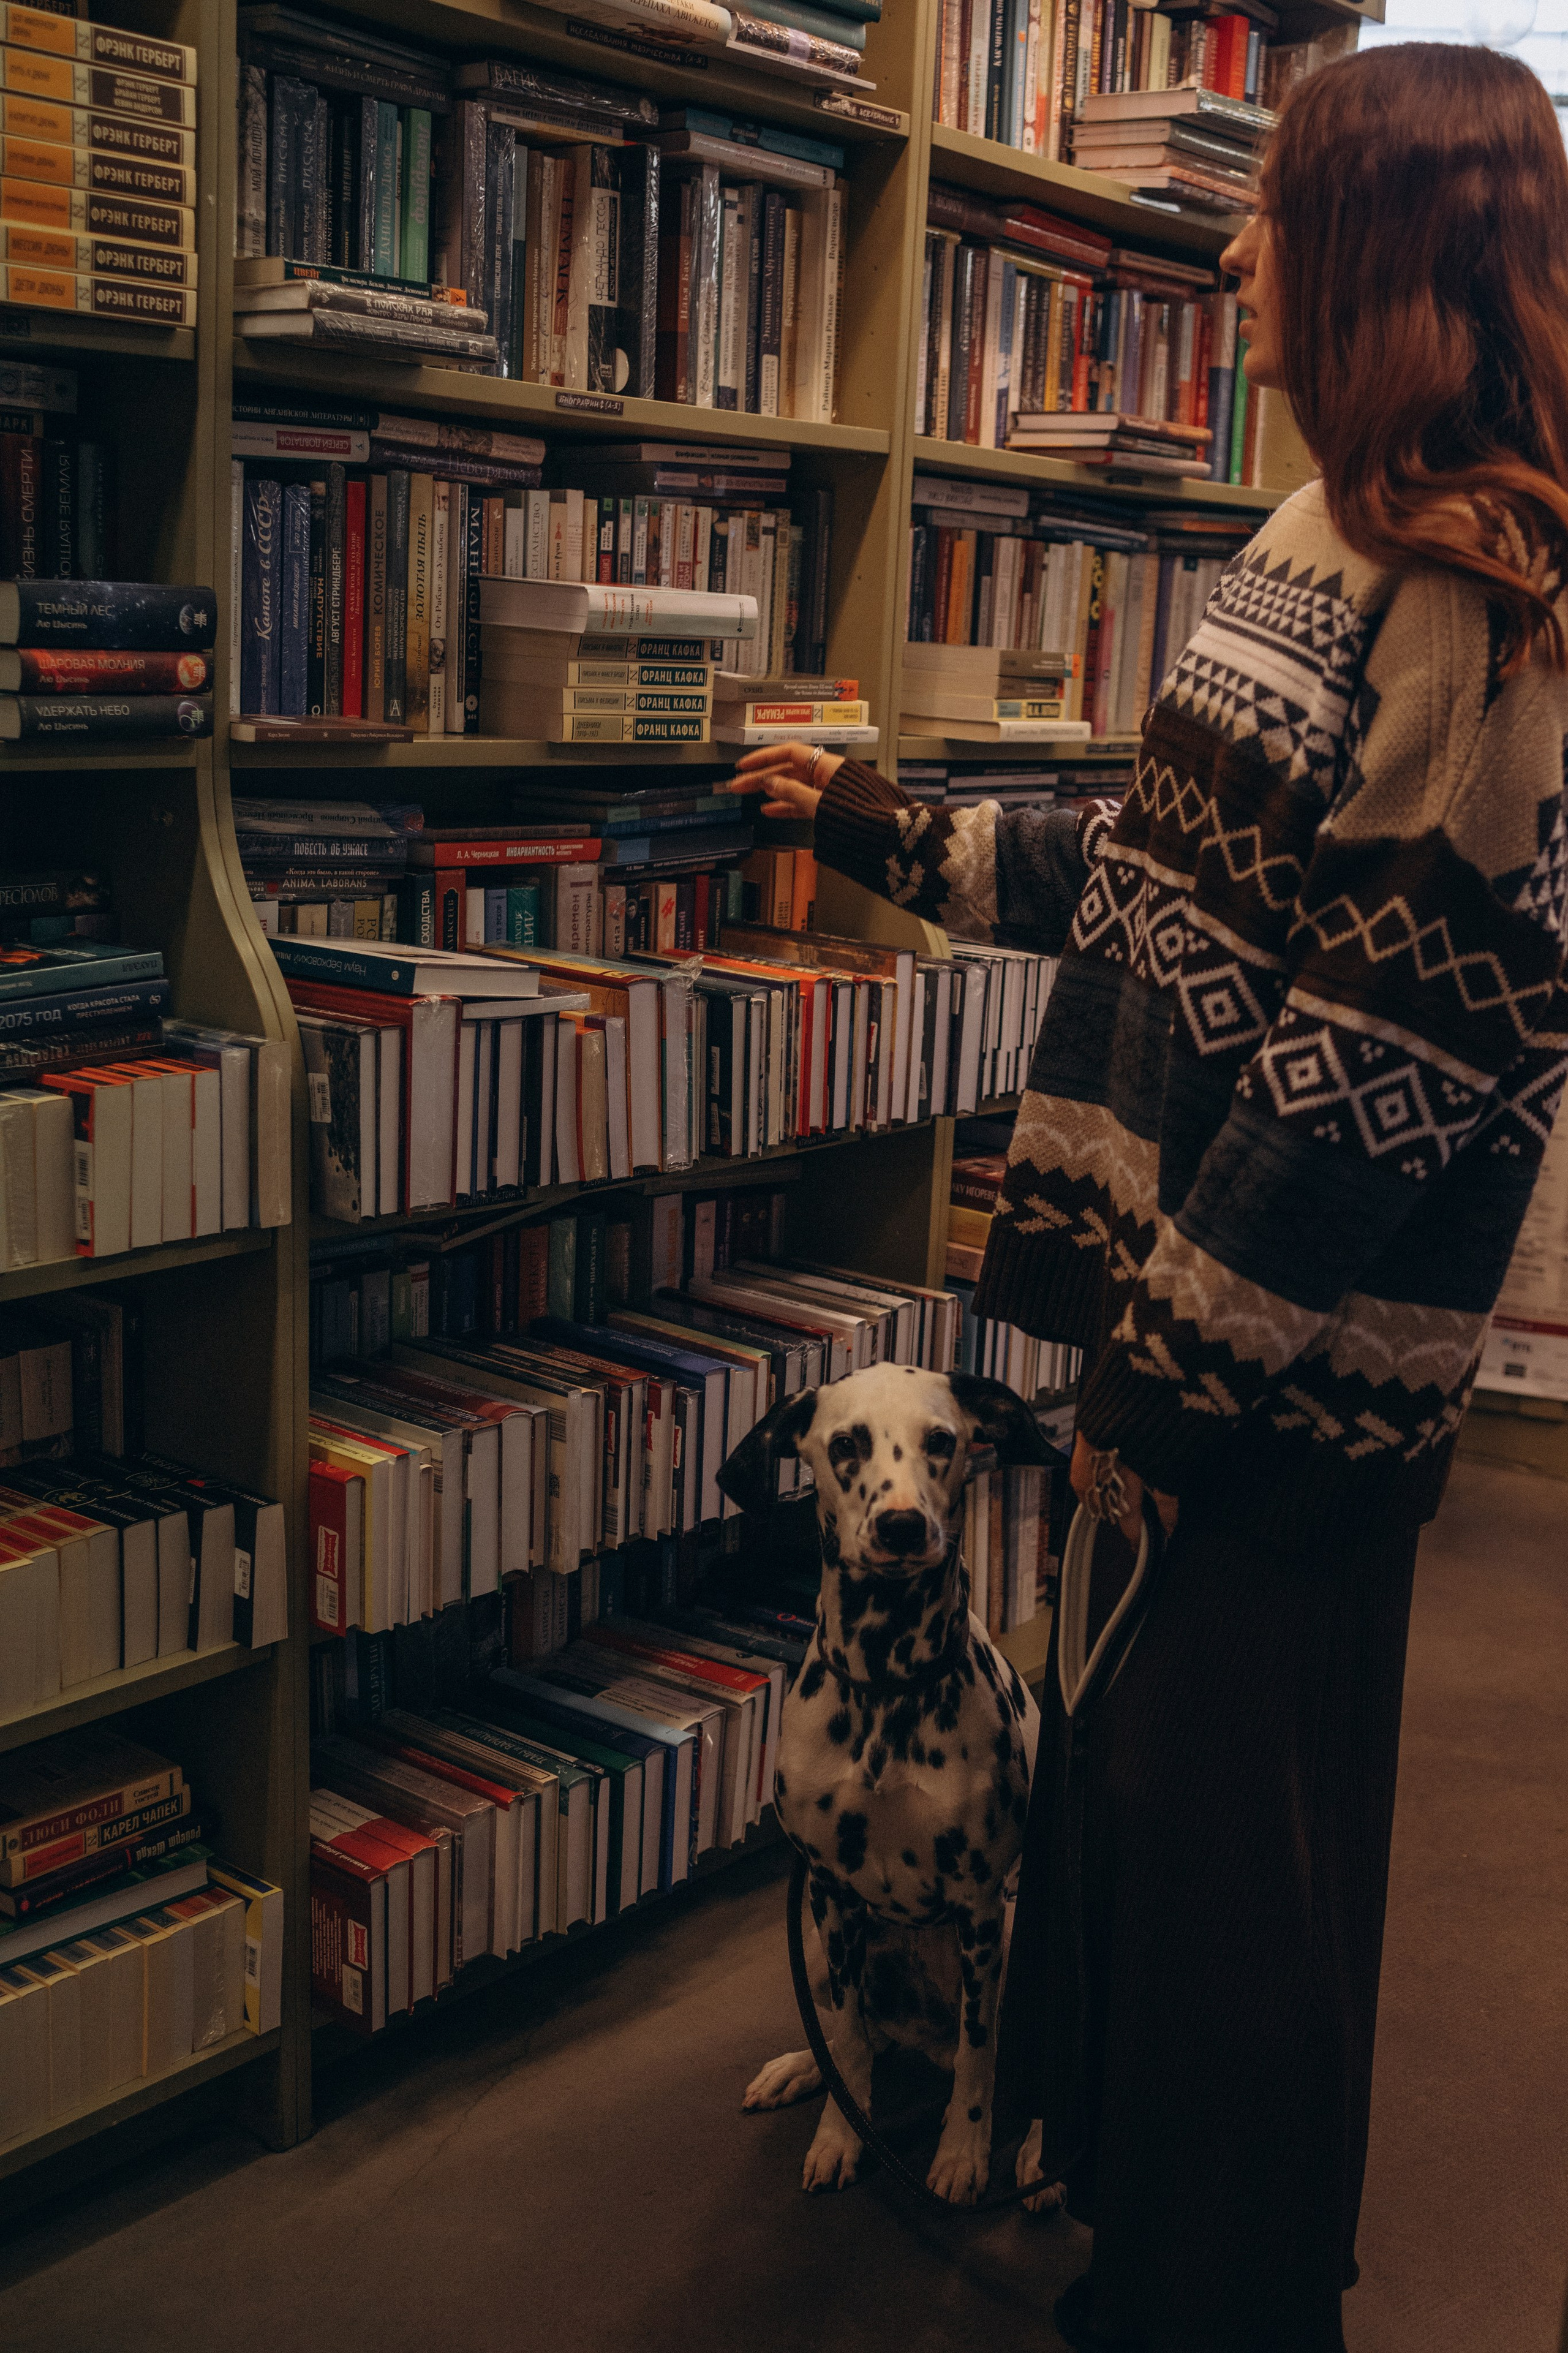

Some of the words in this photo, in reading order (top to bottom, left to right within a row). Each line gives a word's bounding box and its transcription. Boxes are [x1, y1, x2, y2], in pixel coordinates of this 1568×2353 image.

[674, 9, 719, 31] ДВИЖЕТСЯ
[96, 36, 134, 60] ФРЭНК
[136, 46, 181, 71] ГЕРБЕРТ
[116, 78, 135, 88] ФРЭНК
[135, 81, 159, 94] ГЕРБЕРТ
[138, 93, 161, 105] ГЕРБЕРТ
[93, 125, 131, 146] ФРЭНК
[133, 132, 178, 154] ГЕРБЕРТ
[253, 123, 263, 153] ЛОНДОН
[278, 114, 288, 184] ПИСЬМА
[303, 119, 314, 189] ПИСЬМА
[94, 165, 132, 185] ФРЭНК
[135, 172, 181, 192] ГЕРБЕРТ
[252, 156, 263, 192] МОЙ
[91, 206, 129, 226] ФРЭНК
[131, 214, 178, 235] ГЕРБЕРТ
[379, 193, 393, 263] ДАНИЕЛЬ
[598, 196, 610, 237] ПЕССОА
[829, 203, 838, 260] Ворпсведе
[96, 249, 134, 270] ФРЭНК
[137, 255, 183, 276] ГЕРБЕРТ
[557, 197, 573, 304] РЕМАРК
[293, 266, 321, 280] ЦВЕЙГ
[595, 241, 608, 301] ФЕРНАНДО
[96, 289, 134, 307] ФРЭНК
[136, 293, 182, 314] ГЕРБЕРТ
[680, 285, 689, 320] Илья
[824, 336, 832, 370] Мария
[823, 374, 831, 411] Райнер
[263, 406, 307, 418] АНГЛИЙСКОЙ
[309, 409, 353, 423] ЛИТЕРАТУРЫ
[280, 434, 322, 450] ДОВЛАТОВ
[323, 437, 349, 451] СЕРГЕЙ
[20, 448, 35, 523] СМЕРТИ
[59, 455, 72, 515] ЗЕМЛЯ
[258, 493, 272, 555] СССР
[418, 513, 426, 554] ПЫЛЬ
[436, 524, 445, 567] Уэльбека
[373, 510, 385, 615] КОМИЧЕСКОЕ
[332, 547, 341, 607] СТРИНДБЕРГ:
[416, 558, 426, 622] ЗОЛОТАЯ
[36, 602, 88, 615] ТЕМНЫЙ
[90, 604, 115, 616] ЛЕС
[253, 580, 271, 641] Капоте
[315, 577, 324, 659] НАПУТСТВИЕ
[435, 616, 443, 629] От
[36, 620, 51, 629] Лю
[52, 621, 88, 630] Цысинь
[331, 610, 341, 644] АВГУСТ
[37, 657, 96, 670] ШАРОВАЯ
[98, 659, 146, 670] МОЛНИЯ
[640, 643, 669, 656] ФРАНЦ
[673, 644, 701, 657] КАФКА
[39, 675, 53, 684] Лю
[55, 676, 90, 684] Цысинь
[641, 670, 672, 684] ФРАНЦ
[675, 670, 704, 684] КАФКА
[35, 705, 98, 717] УДЕРЖАТЬ
[100, 704, 130, 716] НЕБО
[639, 695, 670, 709] ФРАНЦ
[674, 697, 703, 711] КАФКА
[756, 708, 785, 721] РЕМАРК
[37, 722, 53, 731] Лю
[637, 722, 667, 736] ФРАНЦ
[670, 722, 699, 737] КАФКА
[294, 842, 327, 856] ПОВЕСТЬ
[331, 844, 341, 856] ОБ
[342, 844, 368, 856] УЖАСЕ
[506, 845, 555, 857] ИНВАРИАНТНОСТЬ
[0, 884, 58, 905] РЕСТОЛОВ
[282, 879, 315, 888] ANIMA
[322, 879, 368, 888] LABORANS
[421, 889, 431, 944] СХОДСТВА
[570, 894, 580, 951] времен
[122, 960, 158, 972] ПАУЭЛЛ
[293, 953, 343, 973] Берковский
[344, 961, 367, 976] Наум
[67, 1001, 90, 1011] КОГДА
[91, 997, 119, 1009] КРАСОТА
[120, 994, 140, 1005] СТАЛА
[0, 1011, 33, 1030] 2075
[133, 1784, 160, 1798] Список
[134, 1792, 159, 1805] гостей
[24, 1816, 70, 1848] ЛЮСИ
[75, 1799, 120, 1825] ФОЛИ
[102, 1816, 140, 1842] КАРЕЛ
[143, 1798, 179, 1824] ЧАПЕК
[135, 1838, 166, 1861] Шекли
[167, 1824, 202, 1848] Роберт
